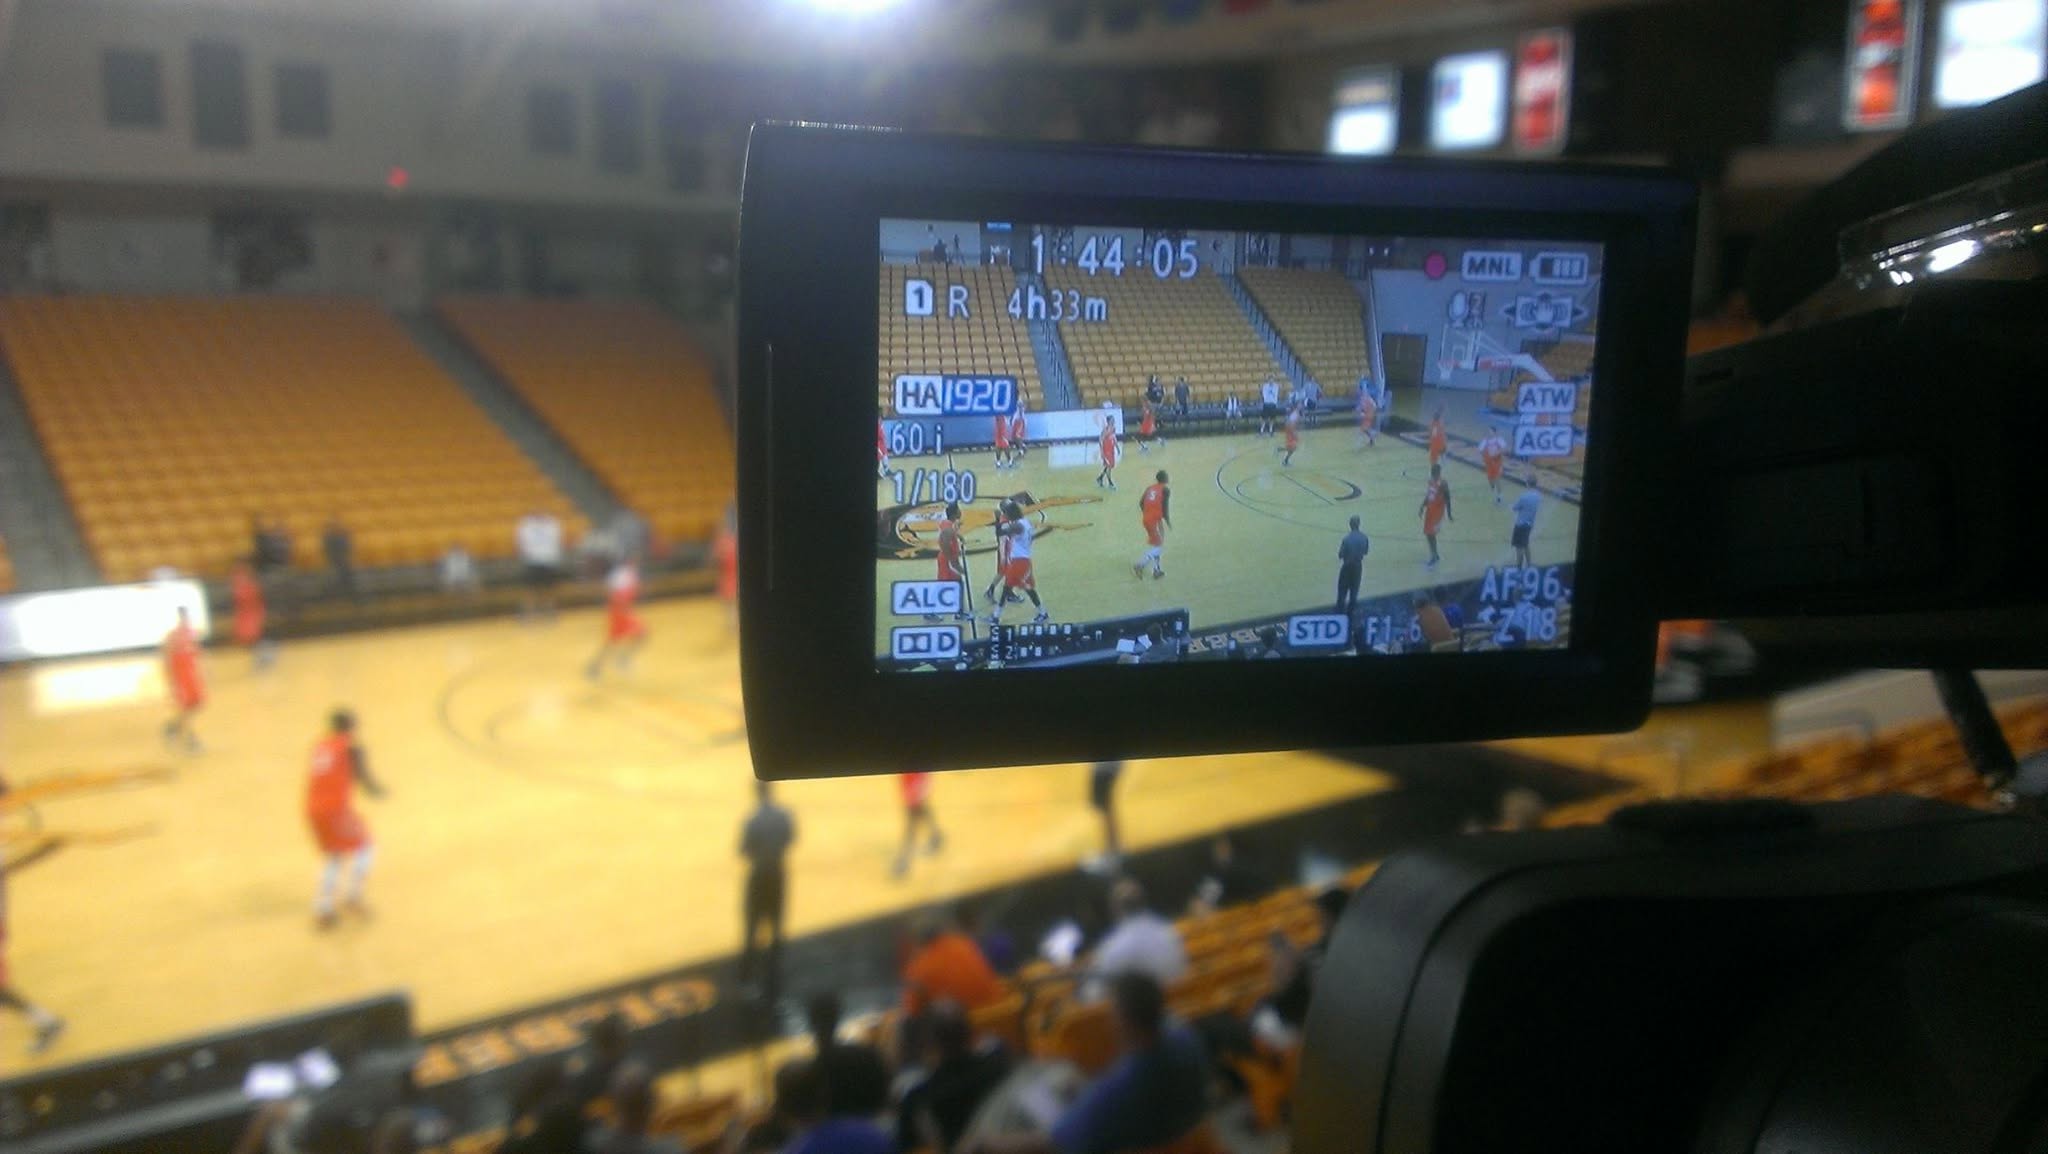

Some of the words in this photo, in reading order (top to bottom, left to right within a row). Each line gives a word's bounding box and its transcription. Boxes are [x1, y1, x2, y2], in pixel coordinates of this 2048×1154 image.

[1032, 234, 1199, 279] 1:44:05
[1467, 256, 1516, 276] MNL
[949, 286, 969, 318] R
[1008, 286, 1108, 322] 4h33m
[1521, 387, 1573, 407] ATW
[1519, 431, 1566, 451] AGC
[894, 469, 974, 507] 1/180
[1480, 566, 1560, 602] AF96
[900, 587, 956, 609] ALC
[1295, 620, 1342, 641] STD
